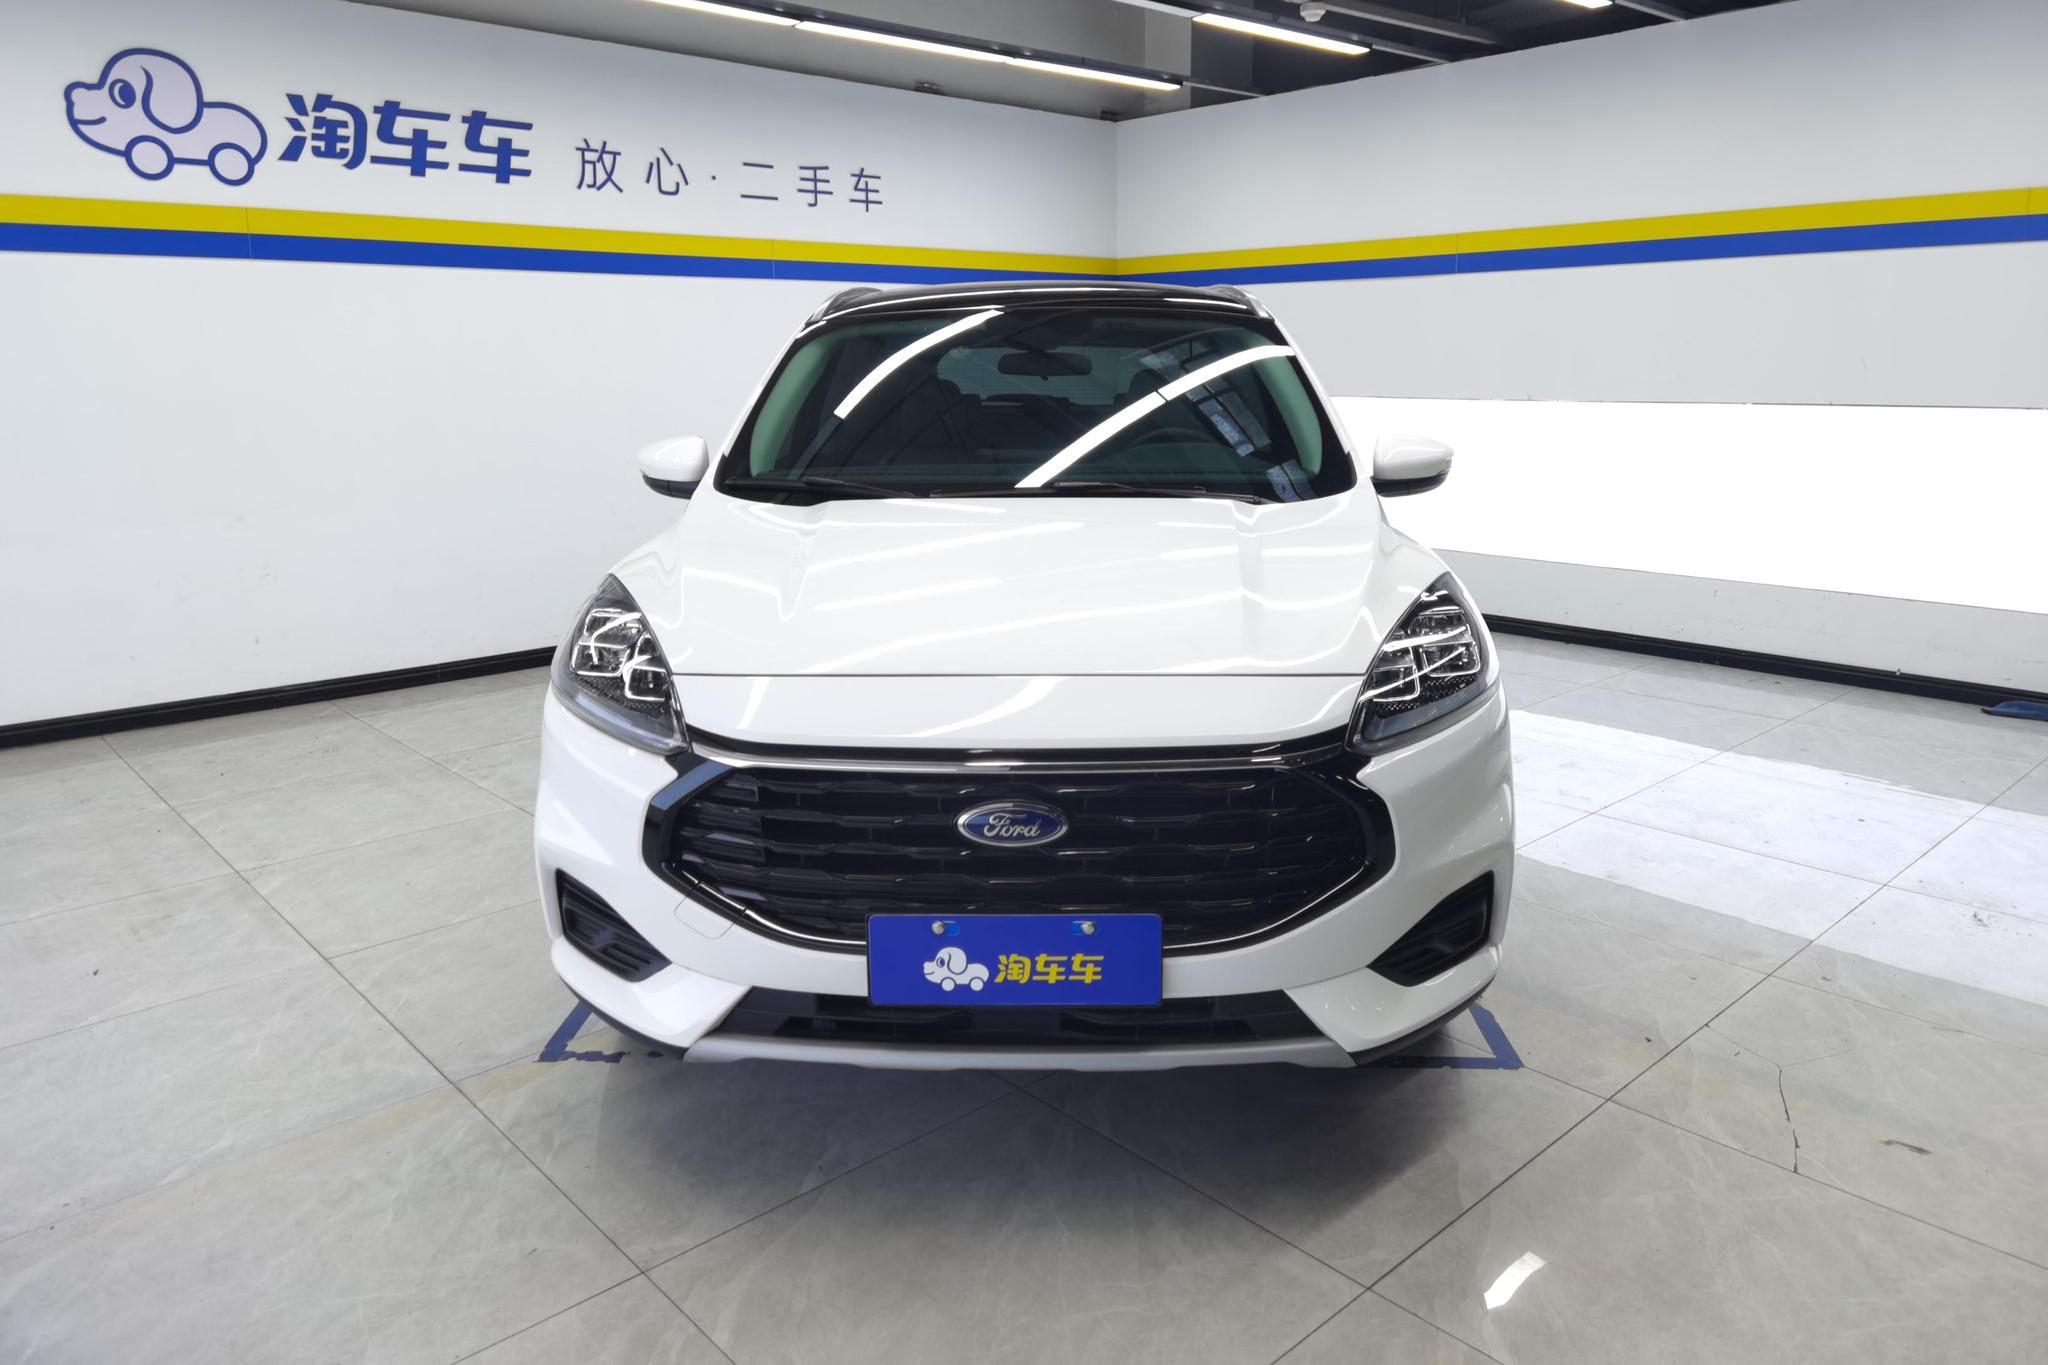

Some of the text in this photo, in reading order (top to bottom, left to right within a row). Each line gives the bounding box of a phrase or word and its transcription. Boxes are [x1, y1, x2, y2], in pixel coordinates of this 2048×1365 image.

[278, 92, 534, 185] 淘车车
[984, 812, 1041, 838] Ford
[994, 952, 1105, 984] 淘车车
